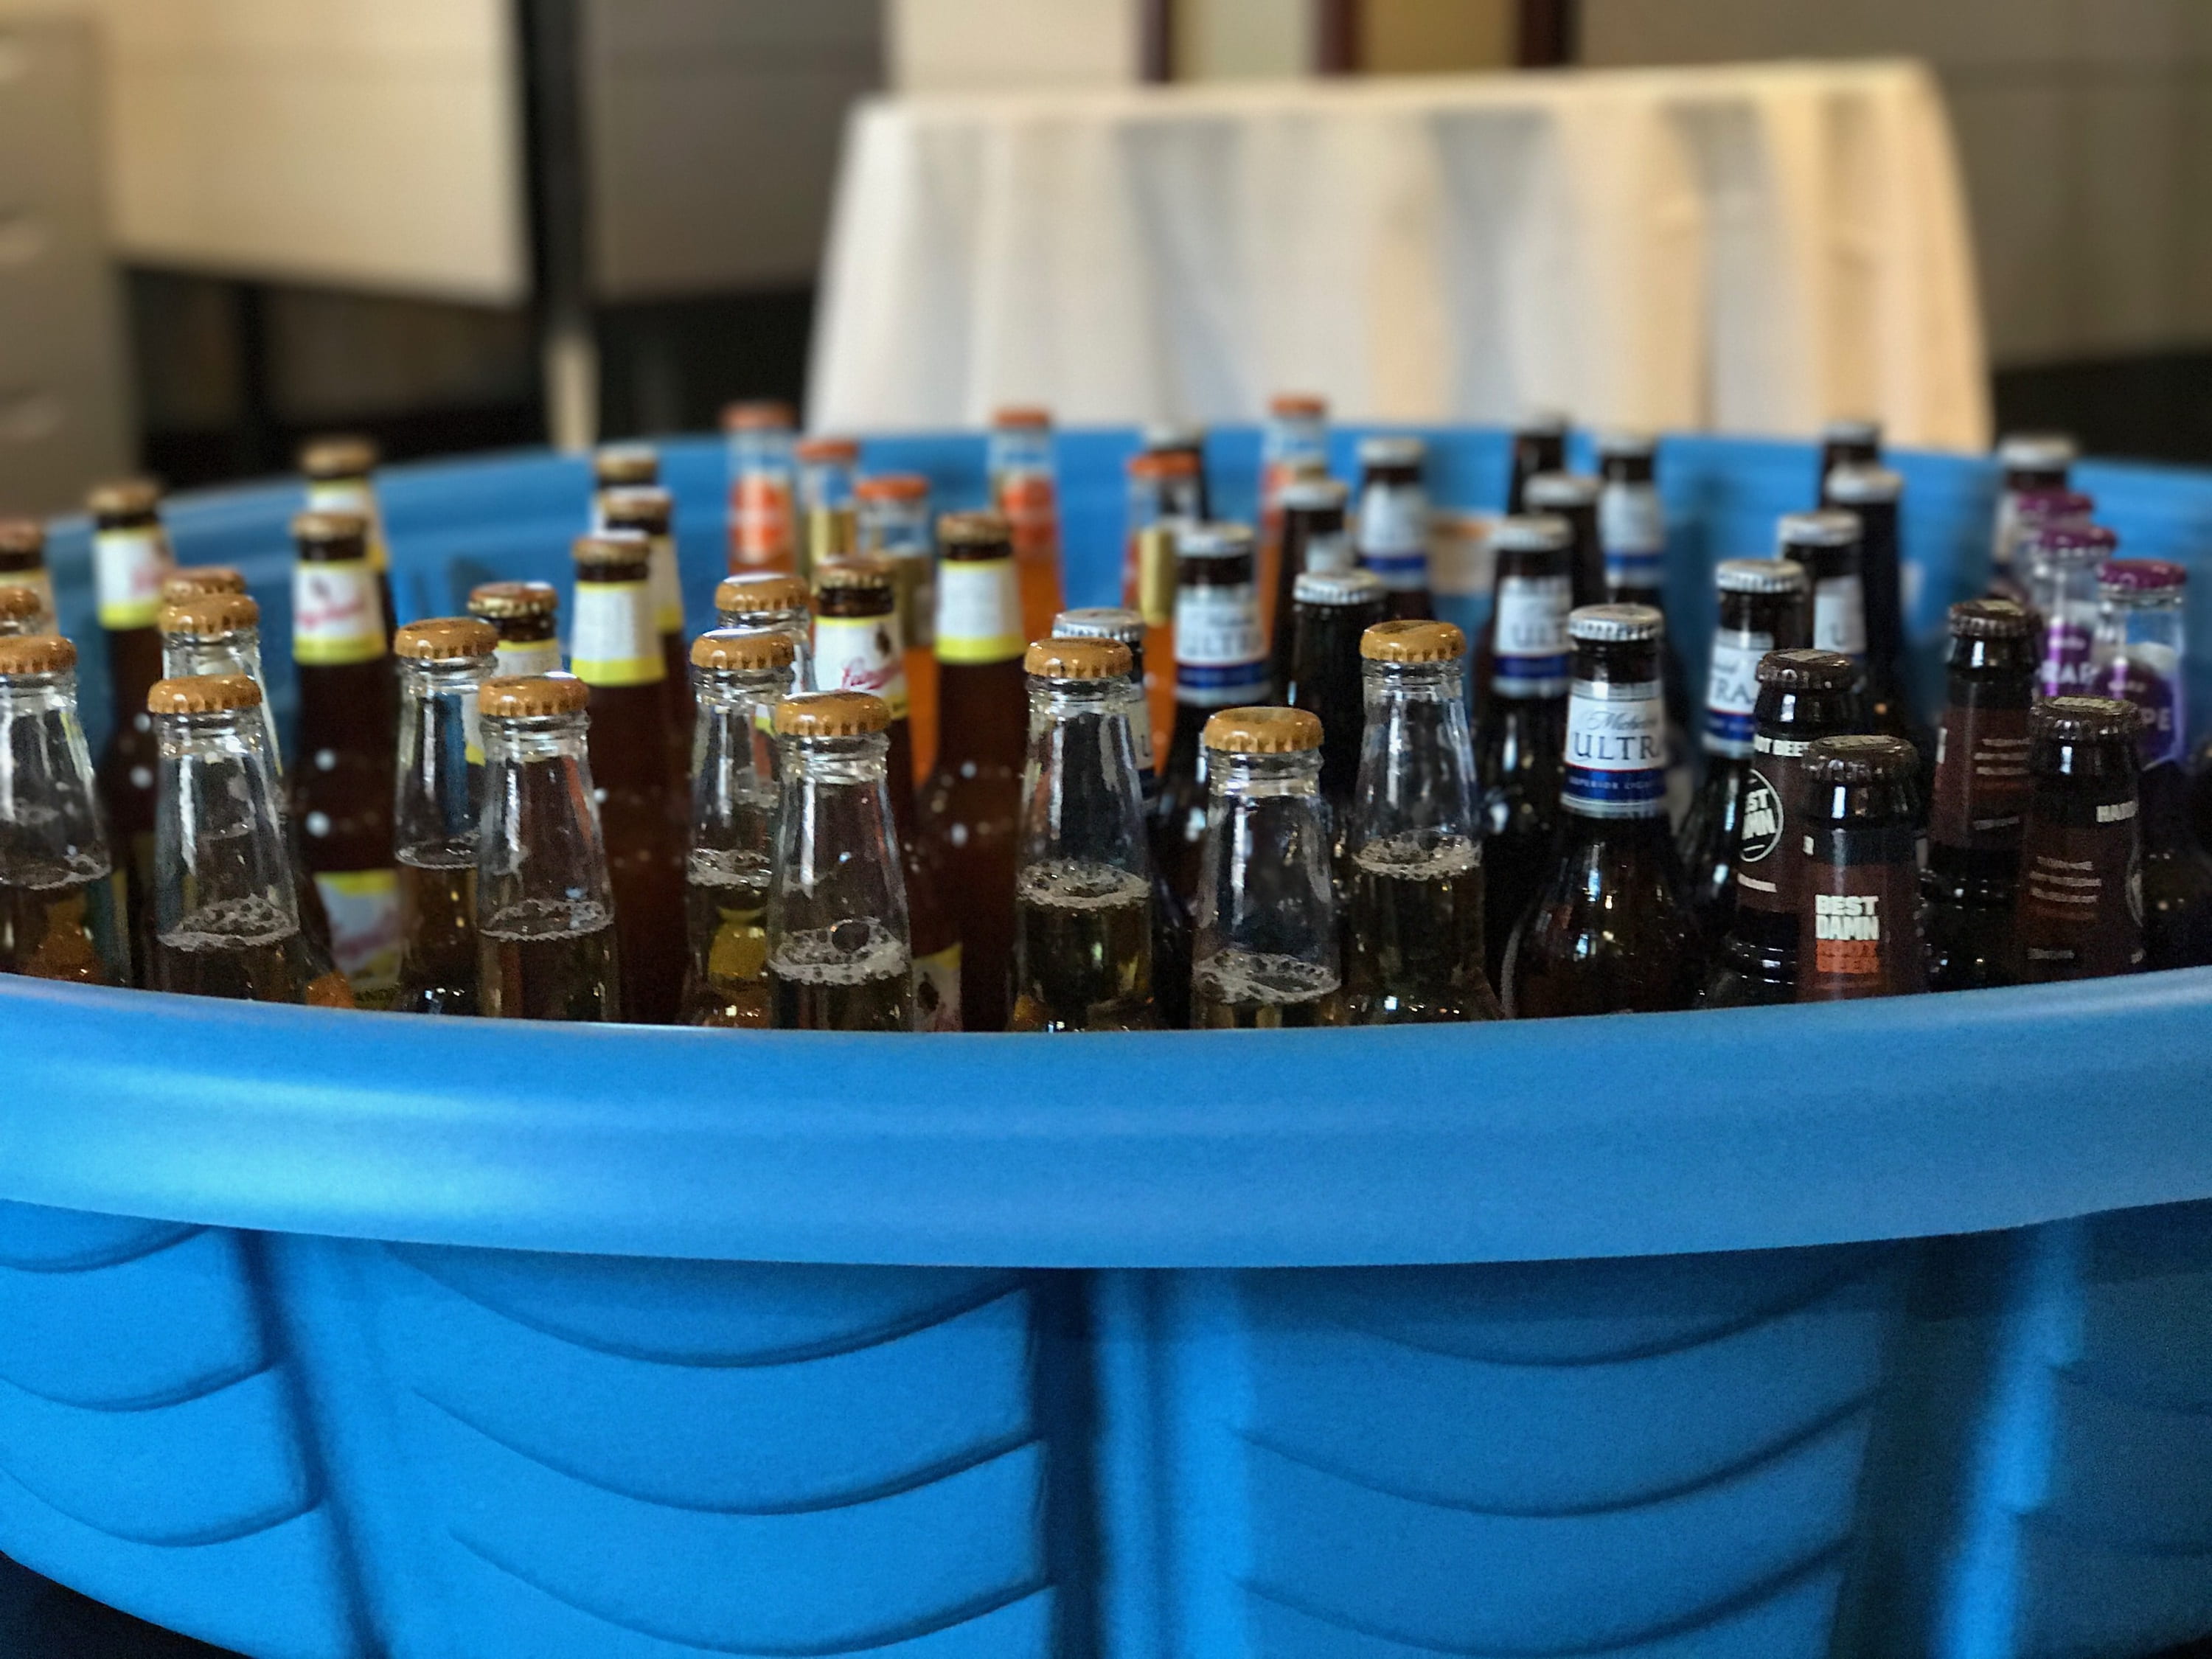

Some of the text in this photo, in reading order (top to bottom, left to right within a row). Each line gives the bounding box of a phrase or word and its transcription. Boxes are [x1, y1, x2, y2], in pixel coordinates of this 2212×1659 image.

[1714, 678, 1757, 705] RA
[2140, 706, 2172, 732] PE
[1573, 732, 1660, 762] ULTR
[1815, 894, 1879, 916] BEST
[1815, 914, 1879, 940] DAMN
